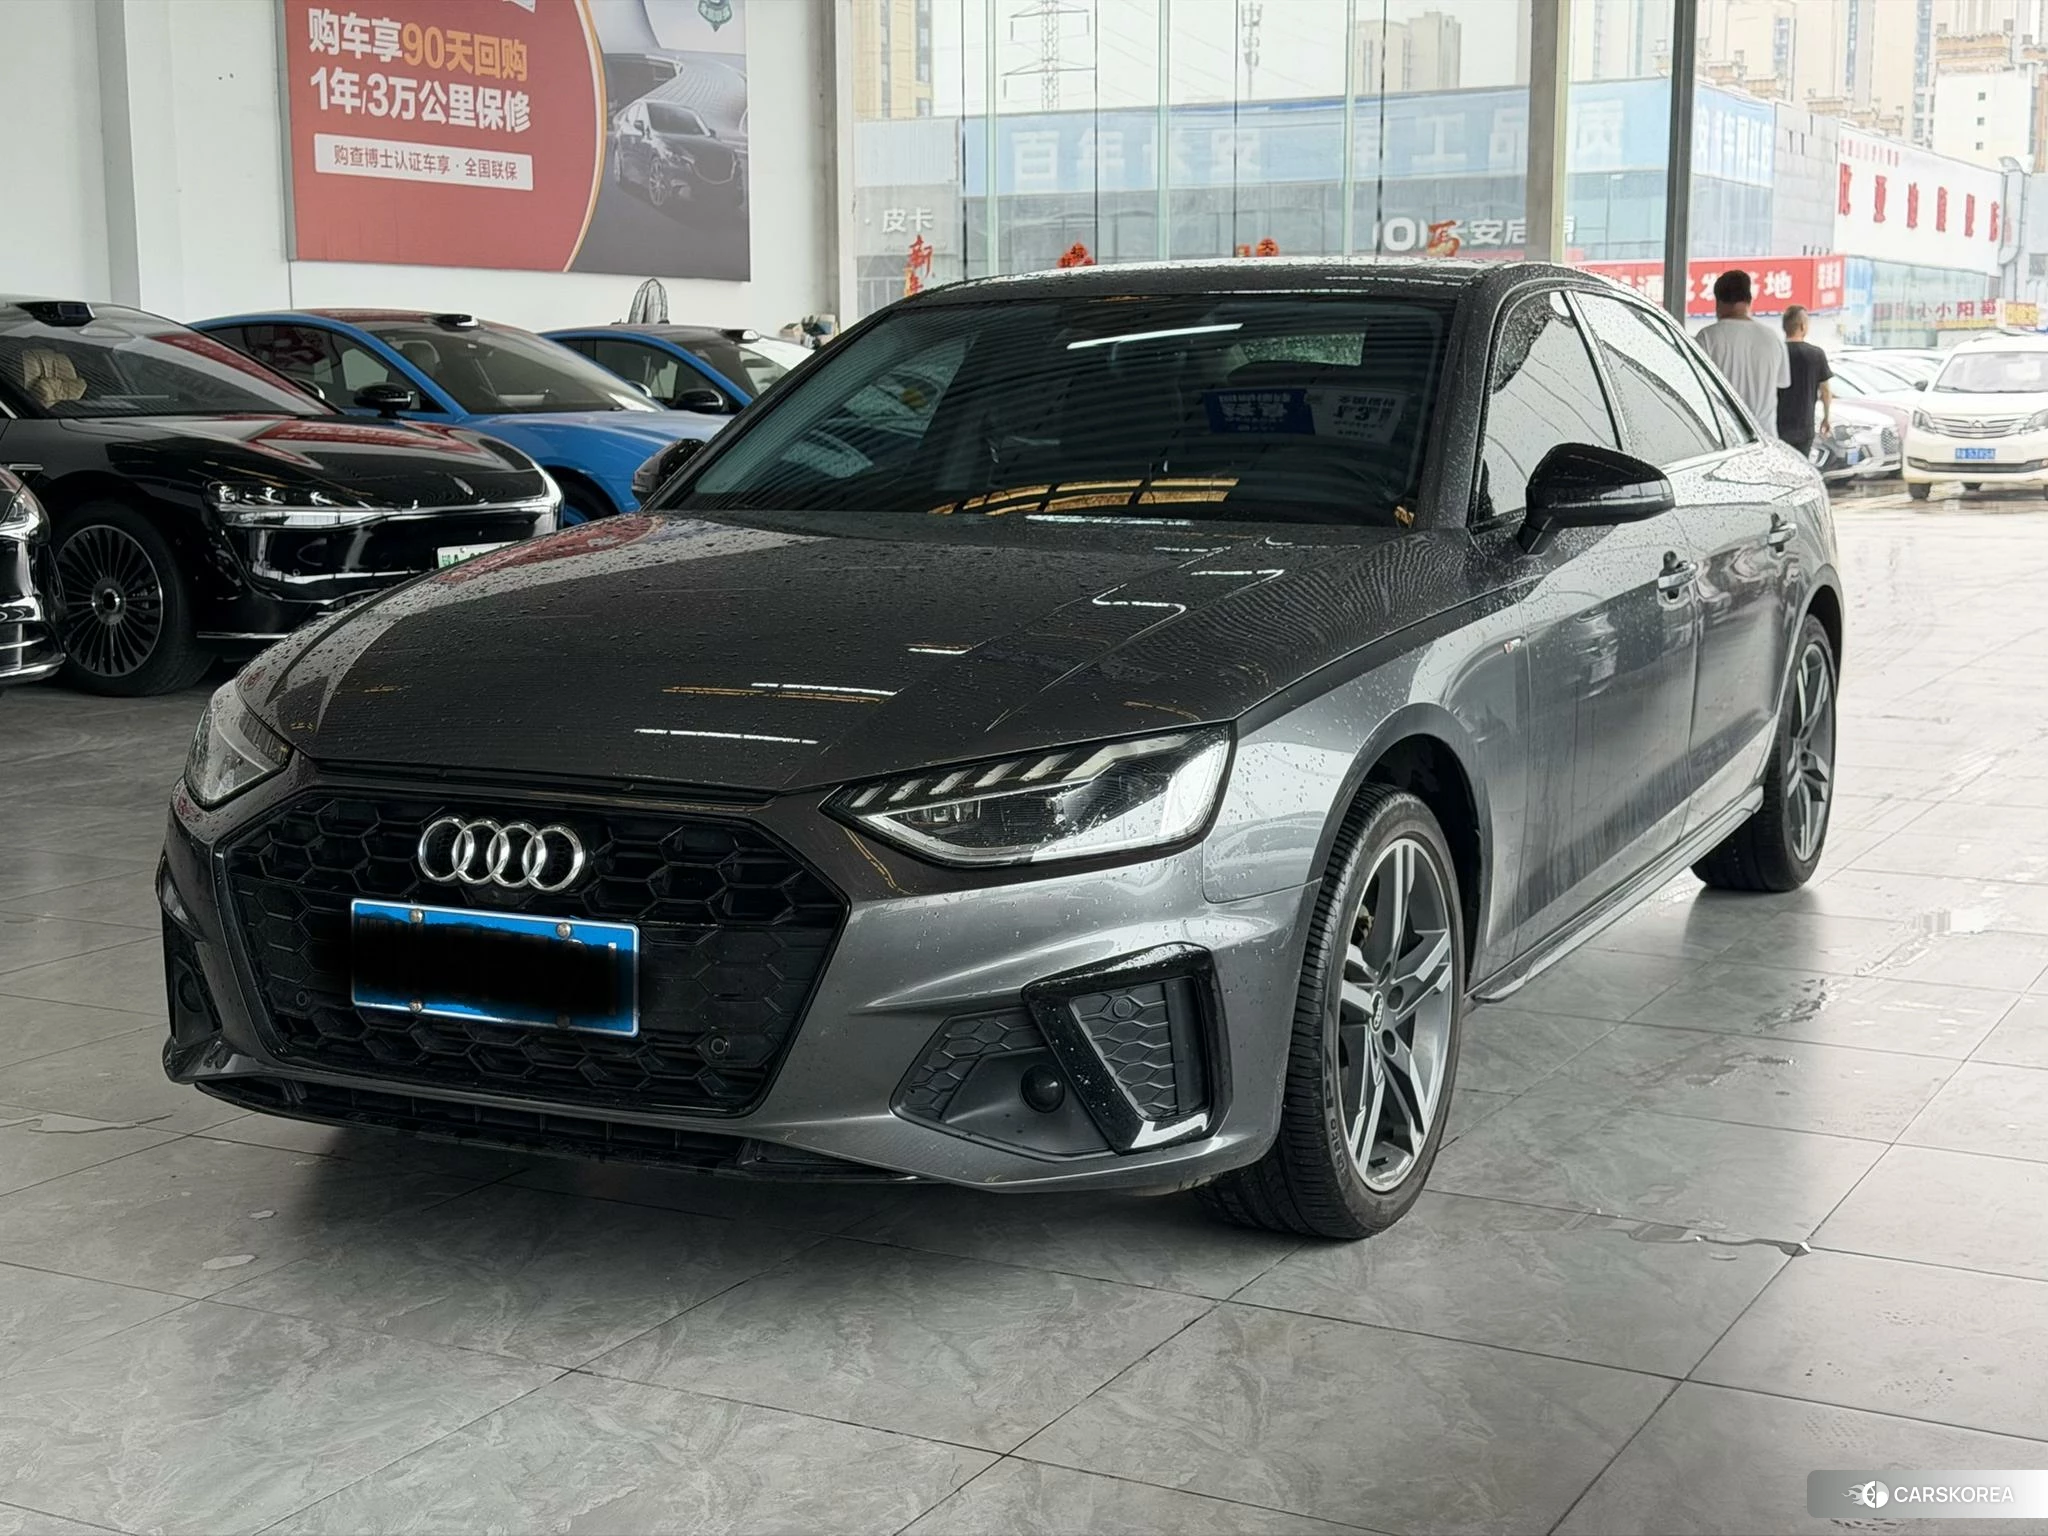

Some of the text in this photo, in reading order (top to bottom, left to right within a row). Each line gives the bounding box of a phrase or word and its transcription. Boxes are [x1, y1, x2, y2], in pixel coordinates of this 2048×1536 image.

[308, 8, 528, 81] 购车享90天回购
[310, 67, 531, 132] 1年/3万公里保修
[882, 207, 934, 233] 皮卡
